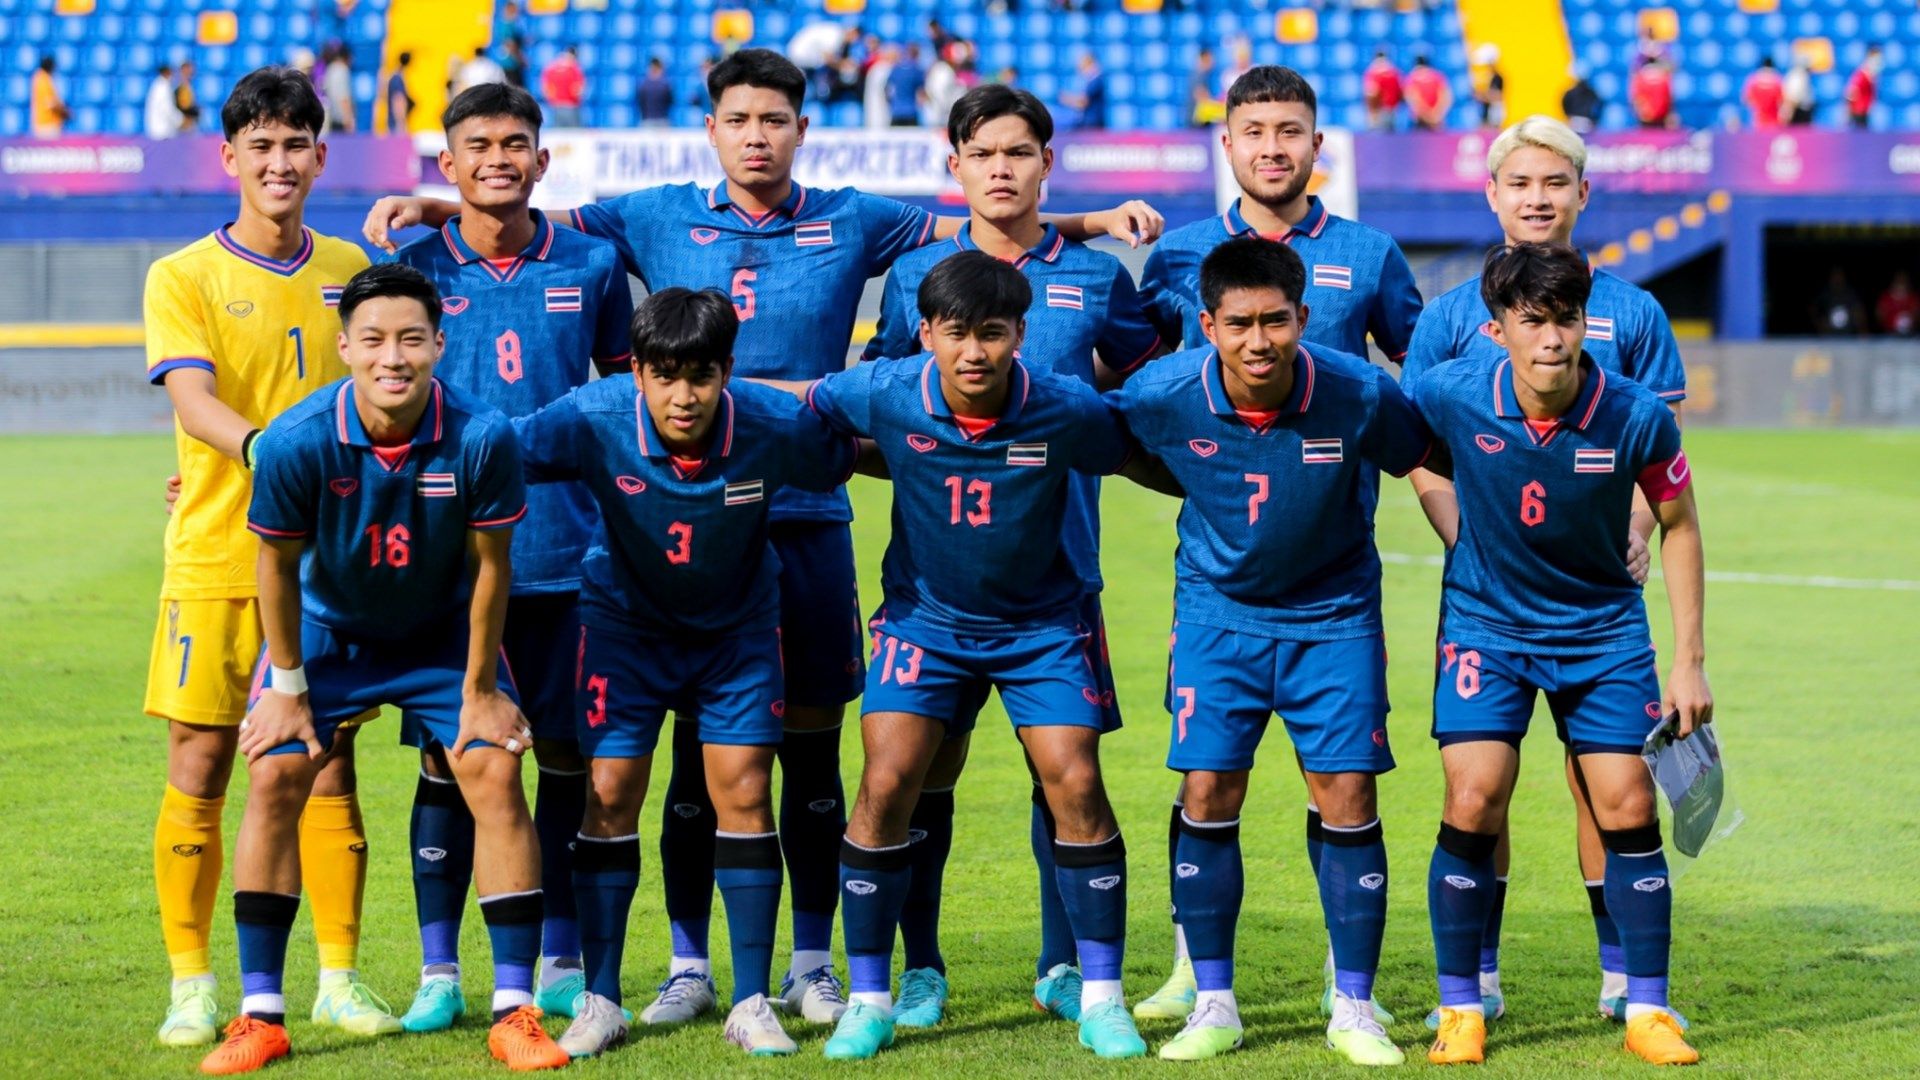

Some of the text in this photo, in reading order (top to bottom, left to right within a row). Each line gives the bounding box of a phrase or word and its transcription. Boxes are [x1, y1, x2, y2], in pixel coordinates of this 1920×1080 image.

[731, 268, 757, 322] 5
[288, 326, 306, 378] 1
[496, 330, 523, 384] 8
[945, 475, 992, 527] 13
[1244, 473, 1270, 525] 7
[1520, 480, 1546, 527] 6
[365, 523, 411, 568] 16
[665, 521, 693, 565] 3
[177, 635, 193, 688] 1
[880, 636, 924, 685] 13
[1456, 650, 1481, 699] 6
[586, 674, 608, 729] 3
[1176, 687, 1195, 743] 7
